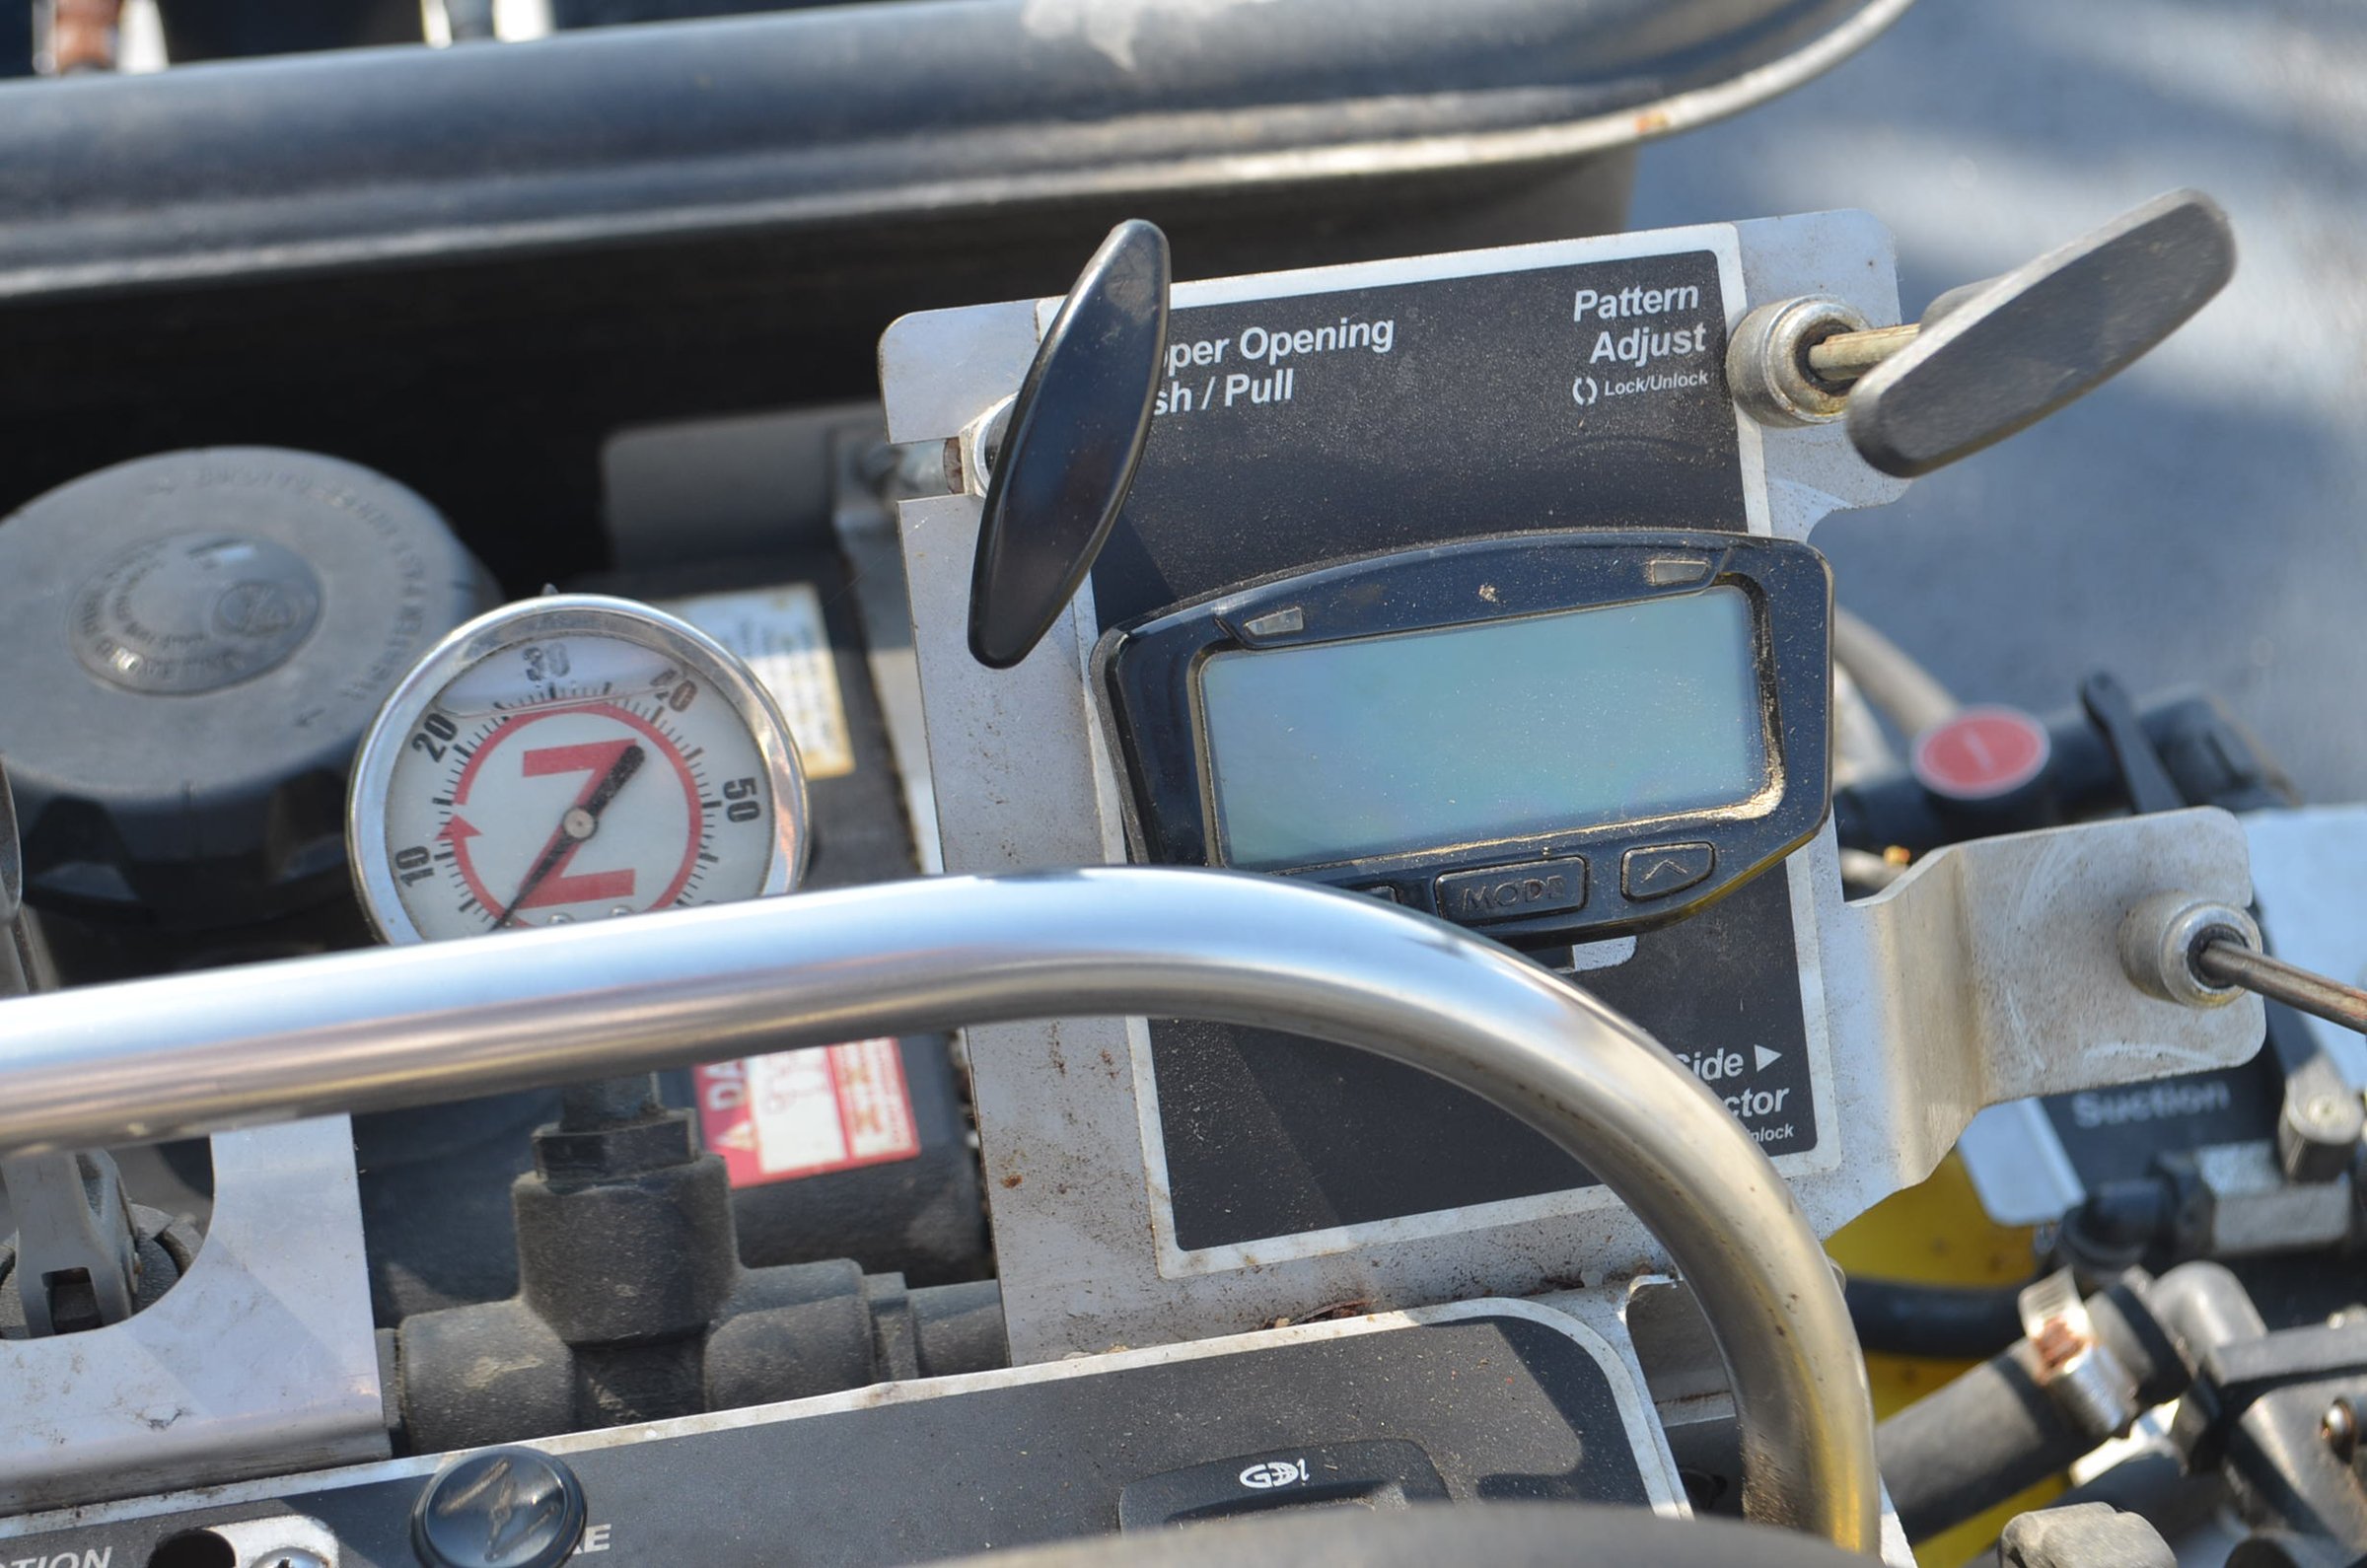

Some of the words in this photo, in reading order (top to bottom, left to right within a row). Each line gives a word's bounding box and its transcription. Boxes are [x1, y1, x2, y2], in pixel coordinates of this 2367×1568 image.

[1573, 285, 1699, 322] Pattern
[1163, 337, 1230, 377] per
[1240, 317, 1395, 367] Opening
[1589, 321, 1707, 368] Adjust
[1224, 368, 1294, 406] Pull
[1604, 370, 1708, 396] Lock/Unlock
[523, 642, 571, 682] 30
[411, 712, 460, 763] 20
[723, 777, 760, 823] 50
[395, 845, 432, 888] 10
[1462, 874, 1566, 913] MODE
[2072, 1082, 2231, 1128] Suction
[1746, 1123, 1794, 1143] nlock
